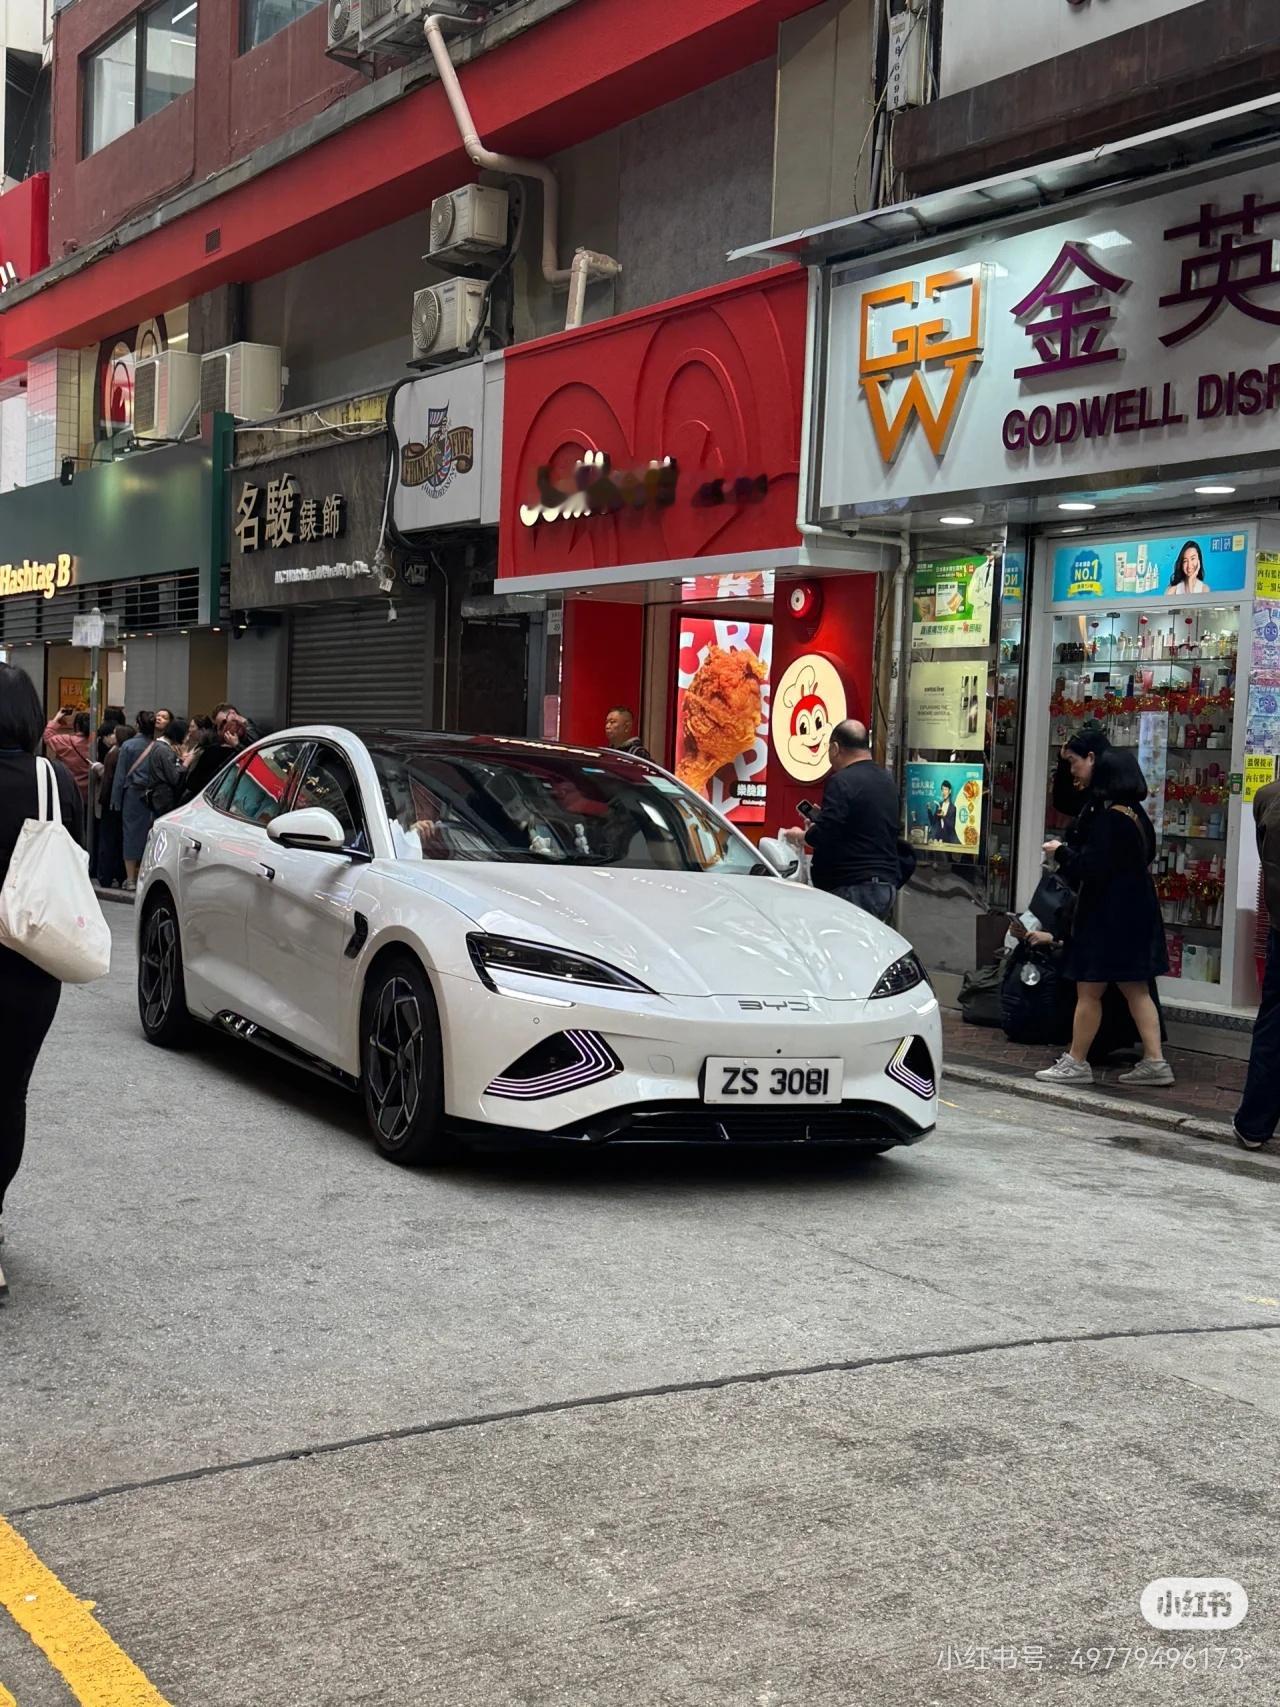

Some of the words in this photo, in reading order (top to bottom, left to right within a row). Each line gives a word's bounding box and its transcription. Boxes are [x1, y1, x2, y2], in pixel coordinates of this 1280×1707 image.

[1002, 383, 1185, 451] GODWELL
[0, 559, 56, 599] Hashtag
[57, 554, 71, 587] B
[1074, 559, 1099, 581] NO.1
[738, 1000, 811, 1011] BYD
[722, 1067, 759, 1095] ZS
[769, 1067, 829, 1095] 3081
